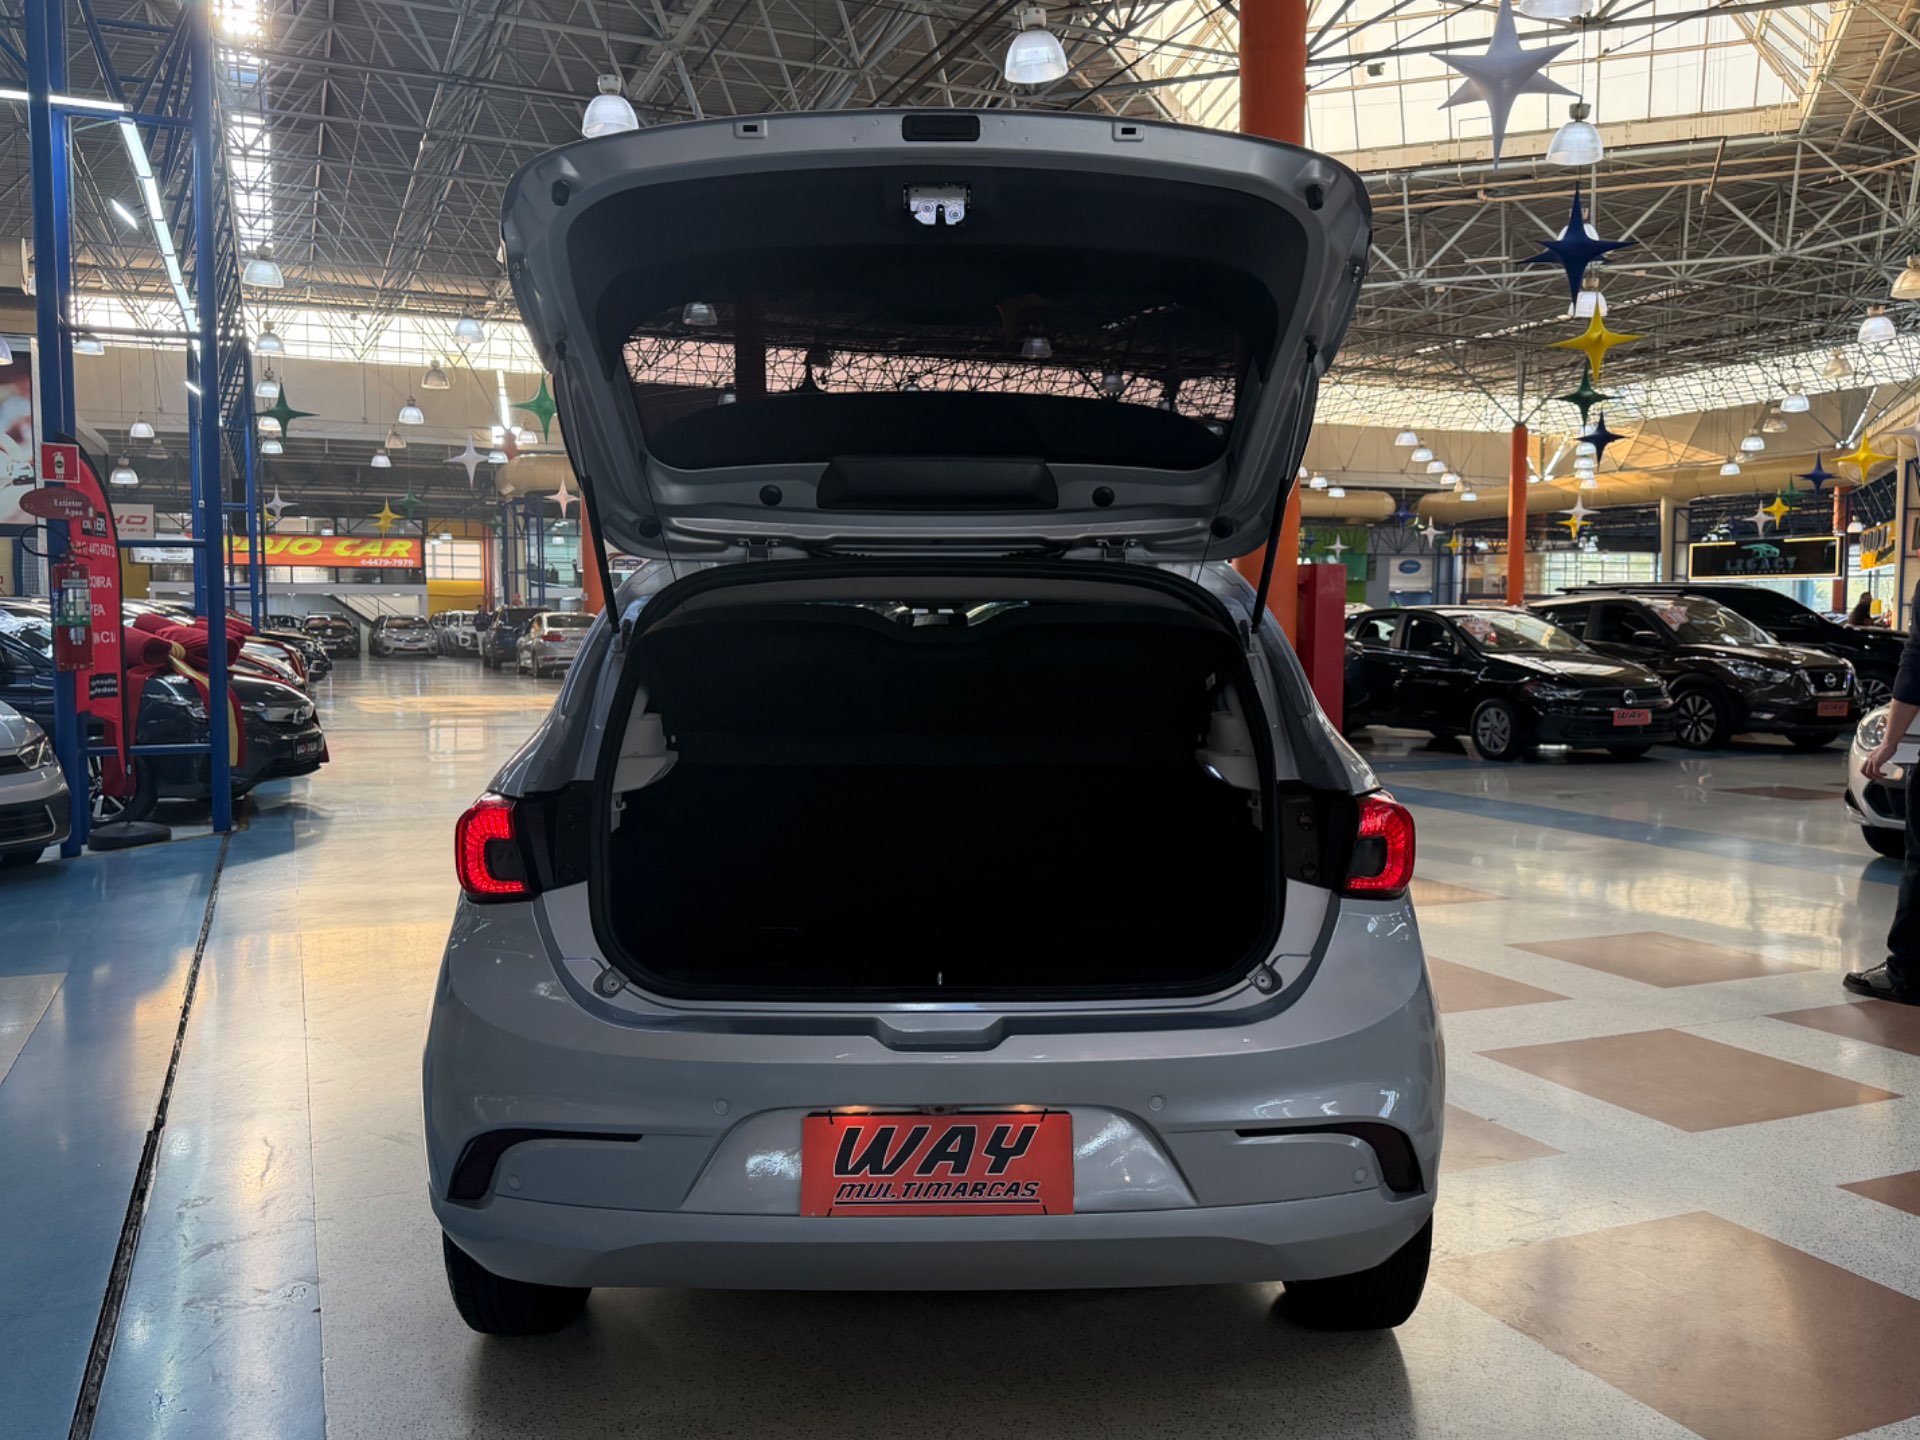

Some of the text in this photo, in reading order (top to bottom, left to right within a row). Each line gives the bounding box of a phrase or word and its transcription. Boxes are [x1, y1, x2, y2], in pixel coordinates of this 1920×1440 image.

[334, 538, 413, 557] CAR
[1726, 556, 1798, 571] LEGACY
[1617, 711, 1645, 720] WAY
[833, 1124, 1040, 1177] WAY
[833, 1181, 1042, 1200] MULTIMARCAS
